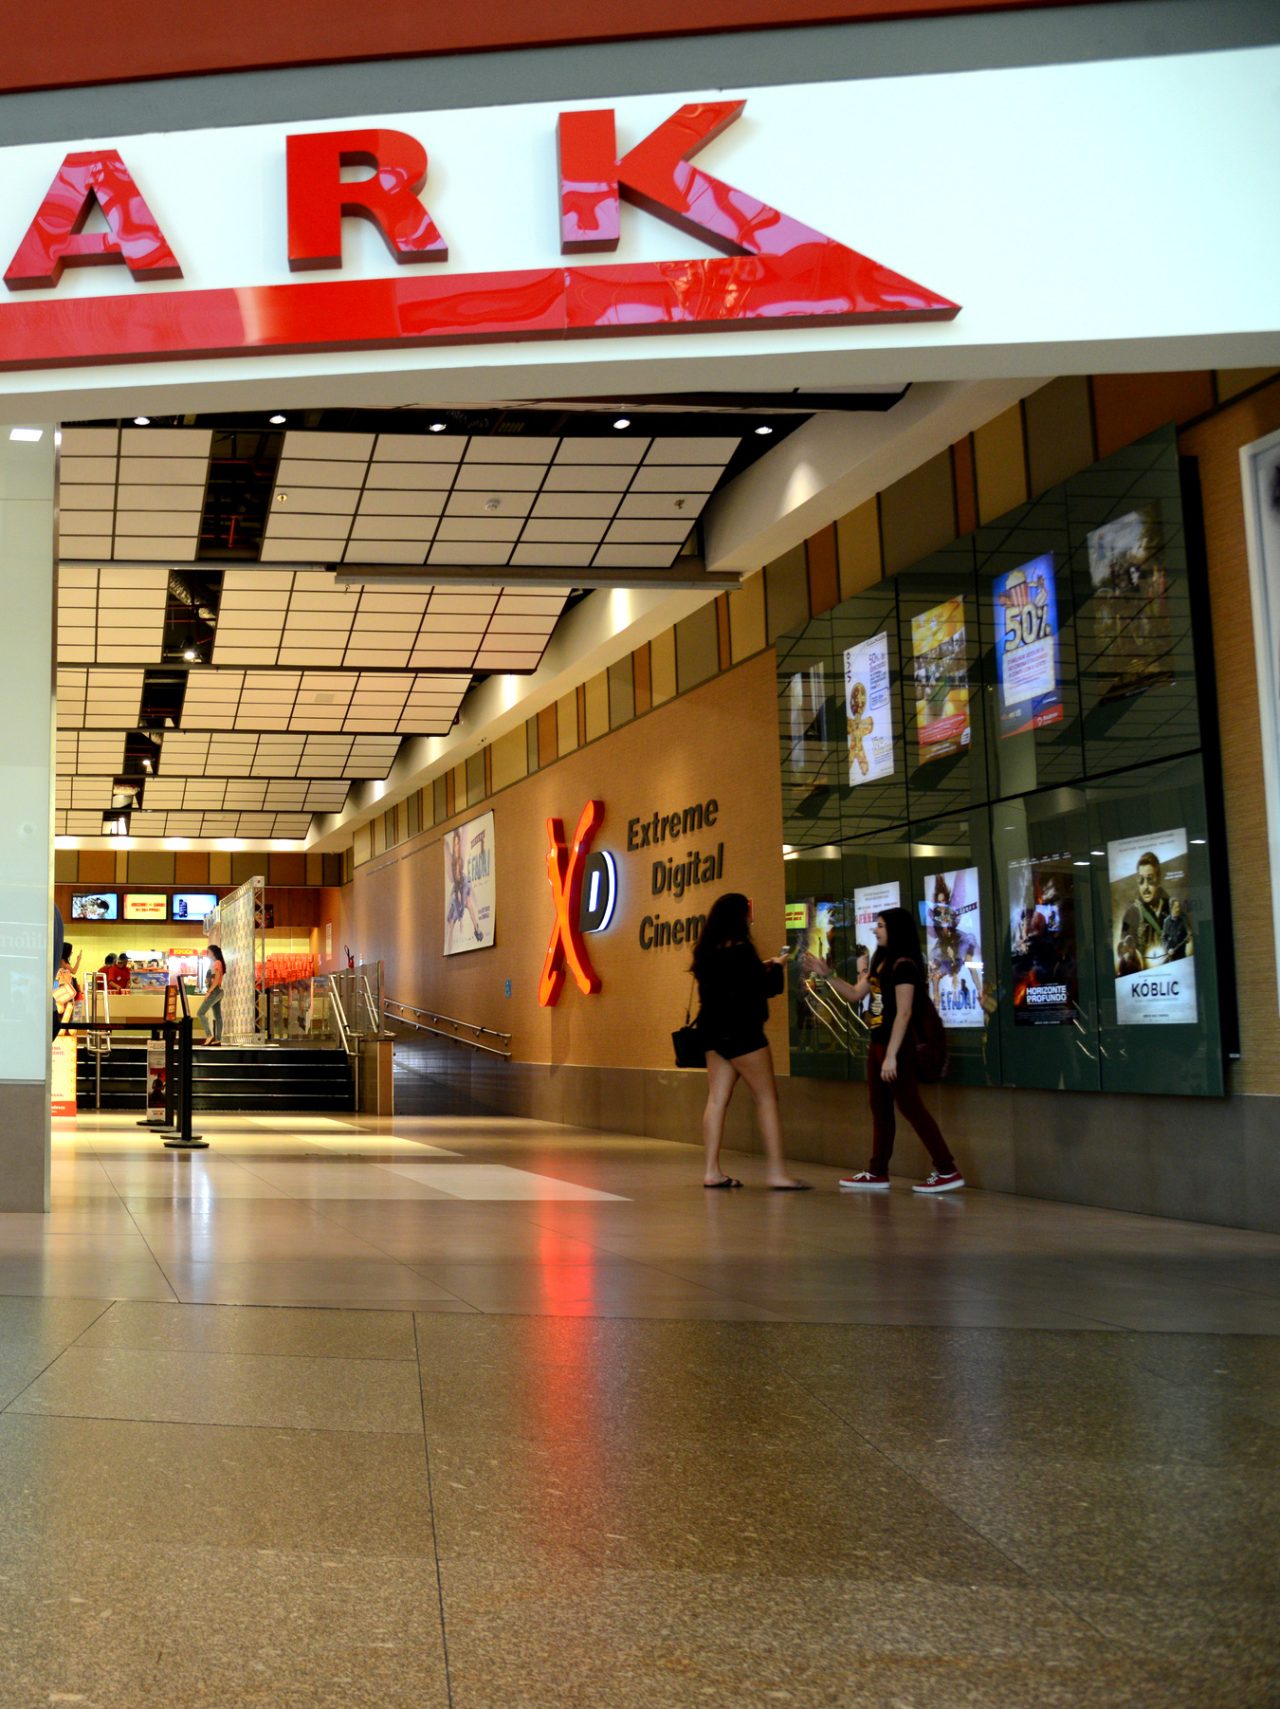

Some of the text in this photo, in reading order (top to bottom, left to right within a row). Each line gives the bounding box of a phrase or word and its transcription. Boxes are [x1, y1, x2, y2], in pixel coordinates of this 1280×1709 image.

[1004, 604, 1052, 652] 50%
[626, 798, 719, 853] Extreme
[651, 841, 725, 898] Digital
[639, 913, 709, 951] Cinem
[1026, 985, 1067, 995] HORIZONTE
[1026, 994, 1067, 1004] PROFUNDO
[1131, 978, 1180, 998] KÓBLIC
